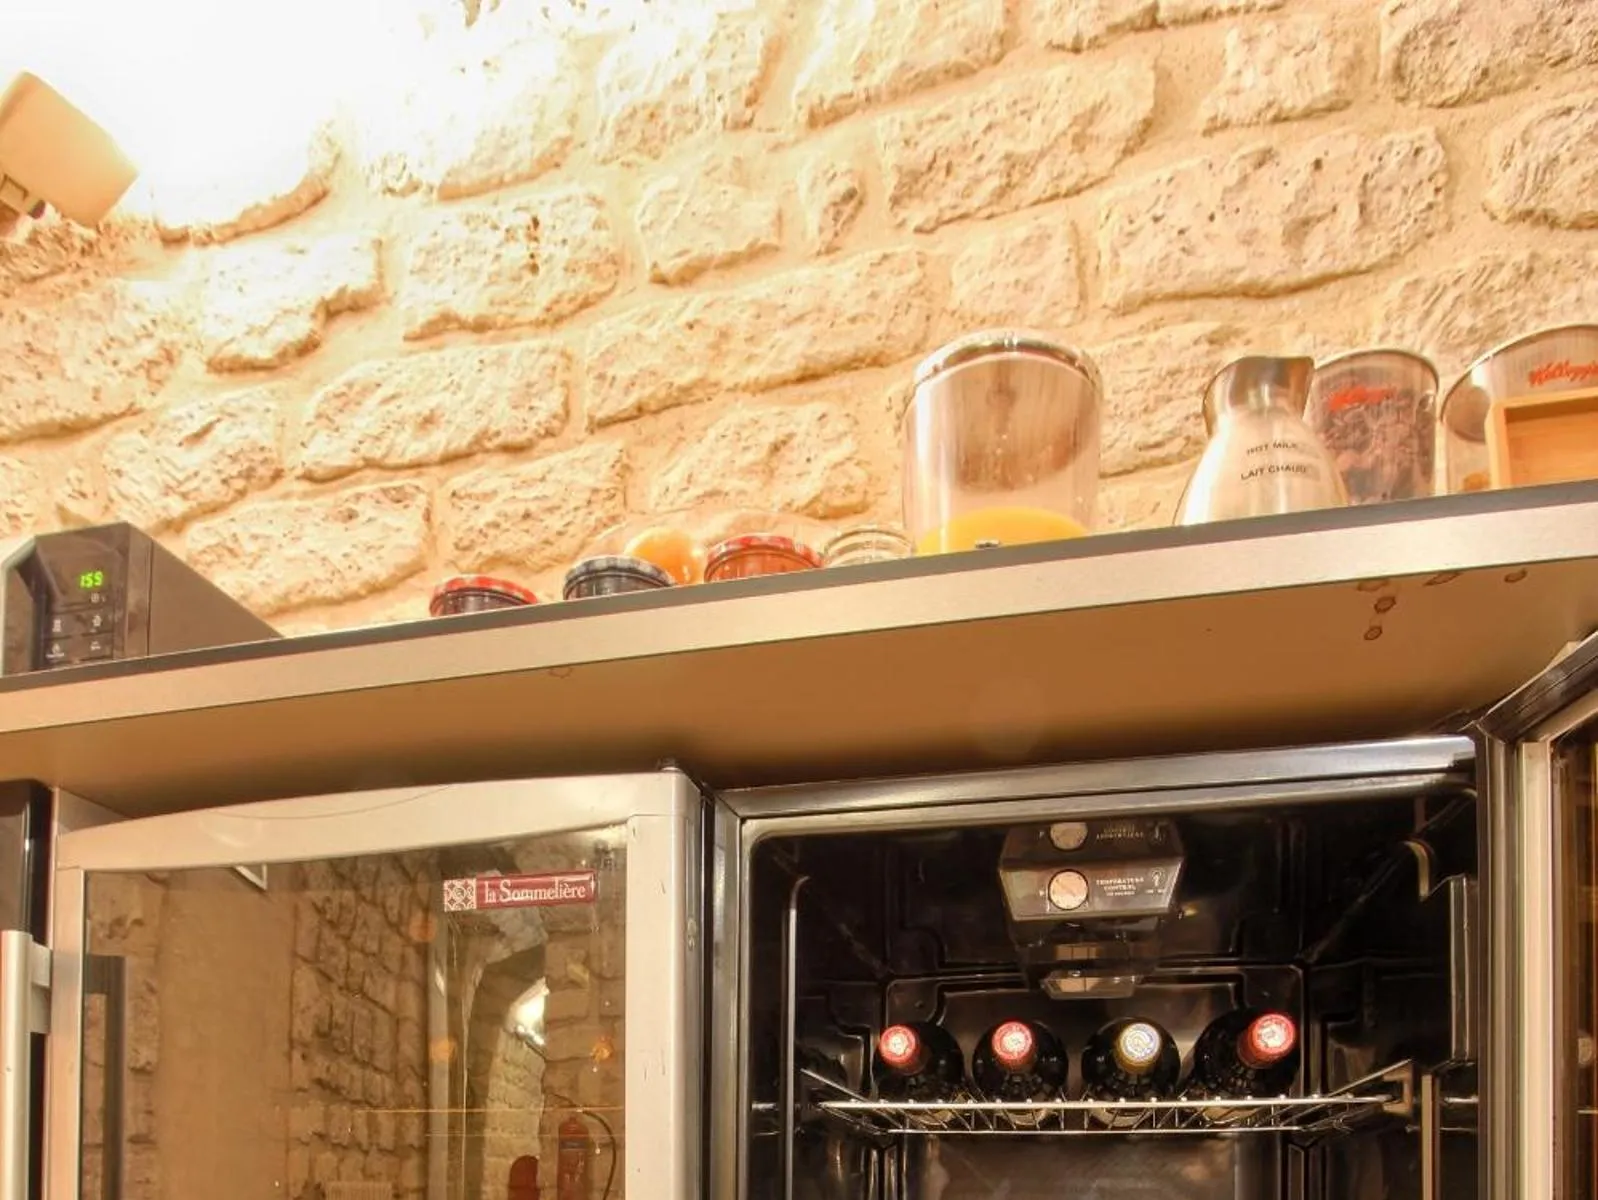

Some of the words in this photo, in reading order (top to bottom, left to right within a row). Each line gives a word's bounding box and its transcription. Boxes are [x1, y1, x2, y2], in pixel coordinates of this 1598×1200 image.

[1240, 467, 1264, 480] LAIT
[484, 881, 497, 903] la
[500, 876, 586, 903] Sommelière
